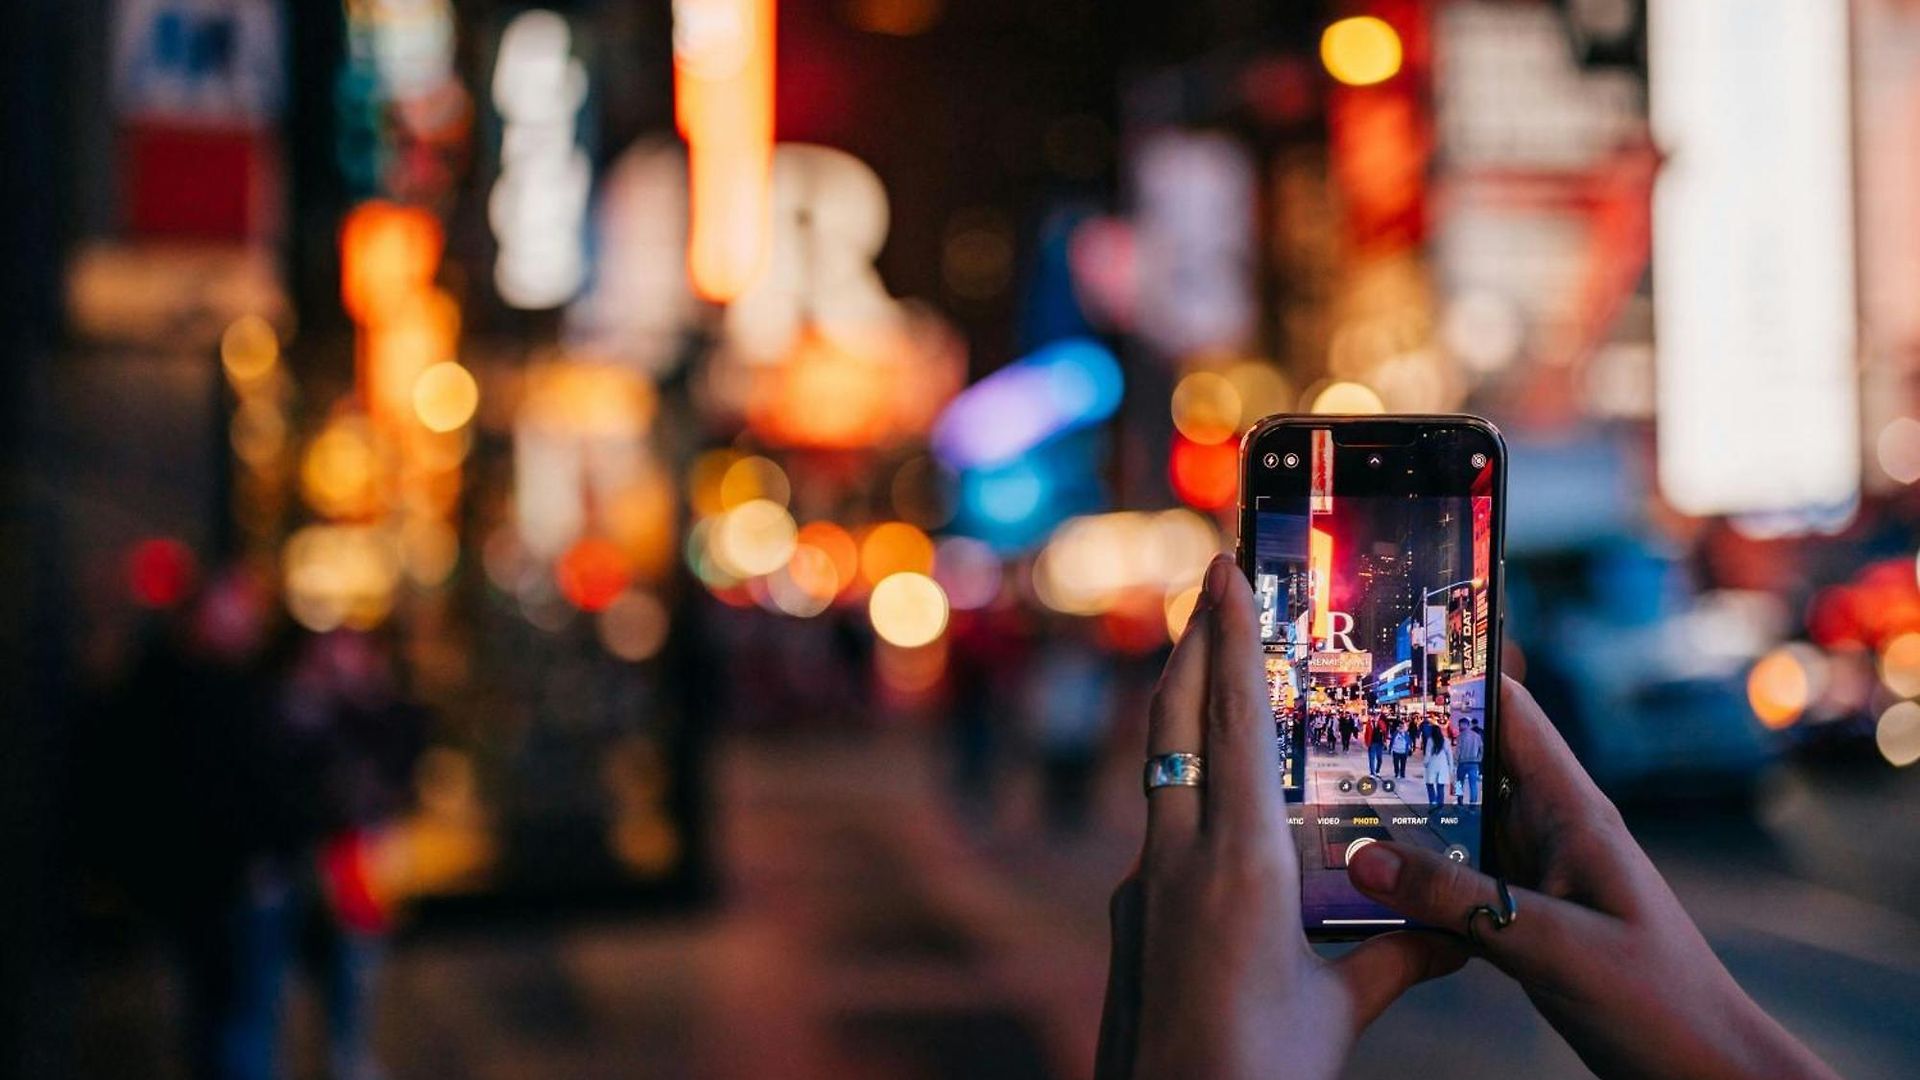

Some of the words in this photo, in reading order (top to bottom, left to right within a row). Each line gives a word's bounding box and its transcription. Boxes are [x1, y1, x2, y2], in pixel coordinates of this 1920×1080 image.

[1319, 611, 1368, 653] R
[1463, 608, 1472, 636] DAT
[1286, 817, 1304, 825] ATIC
[1317, 817, 1340, 825] VIDEO
[1353, 817, 1379, 825] PHOTO
[1392, 817, 1428, 825] PORTRAIT
[1440, 817, 1459, 825] PANO
